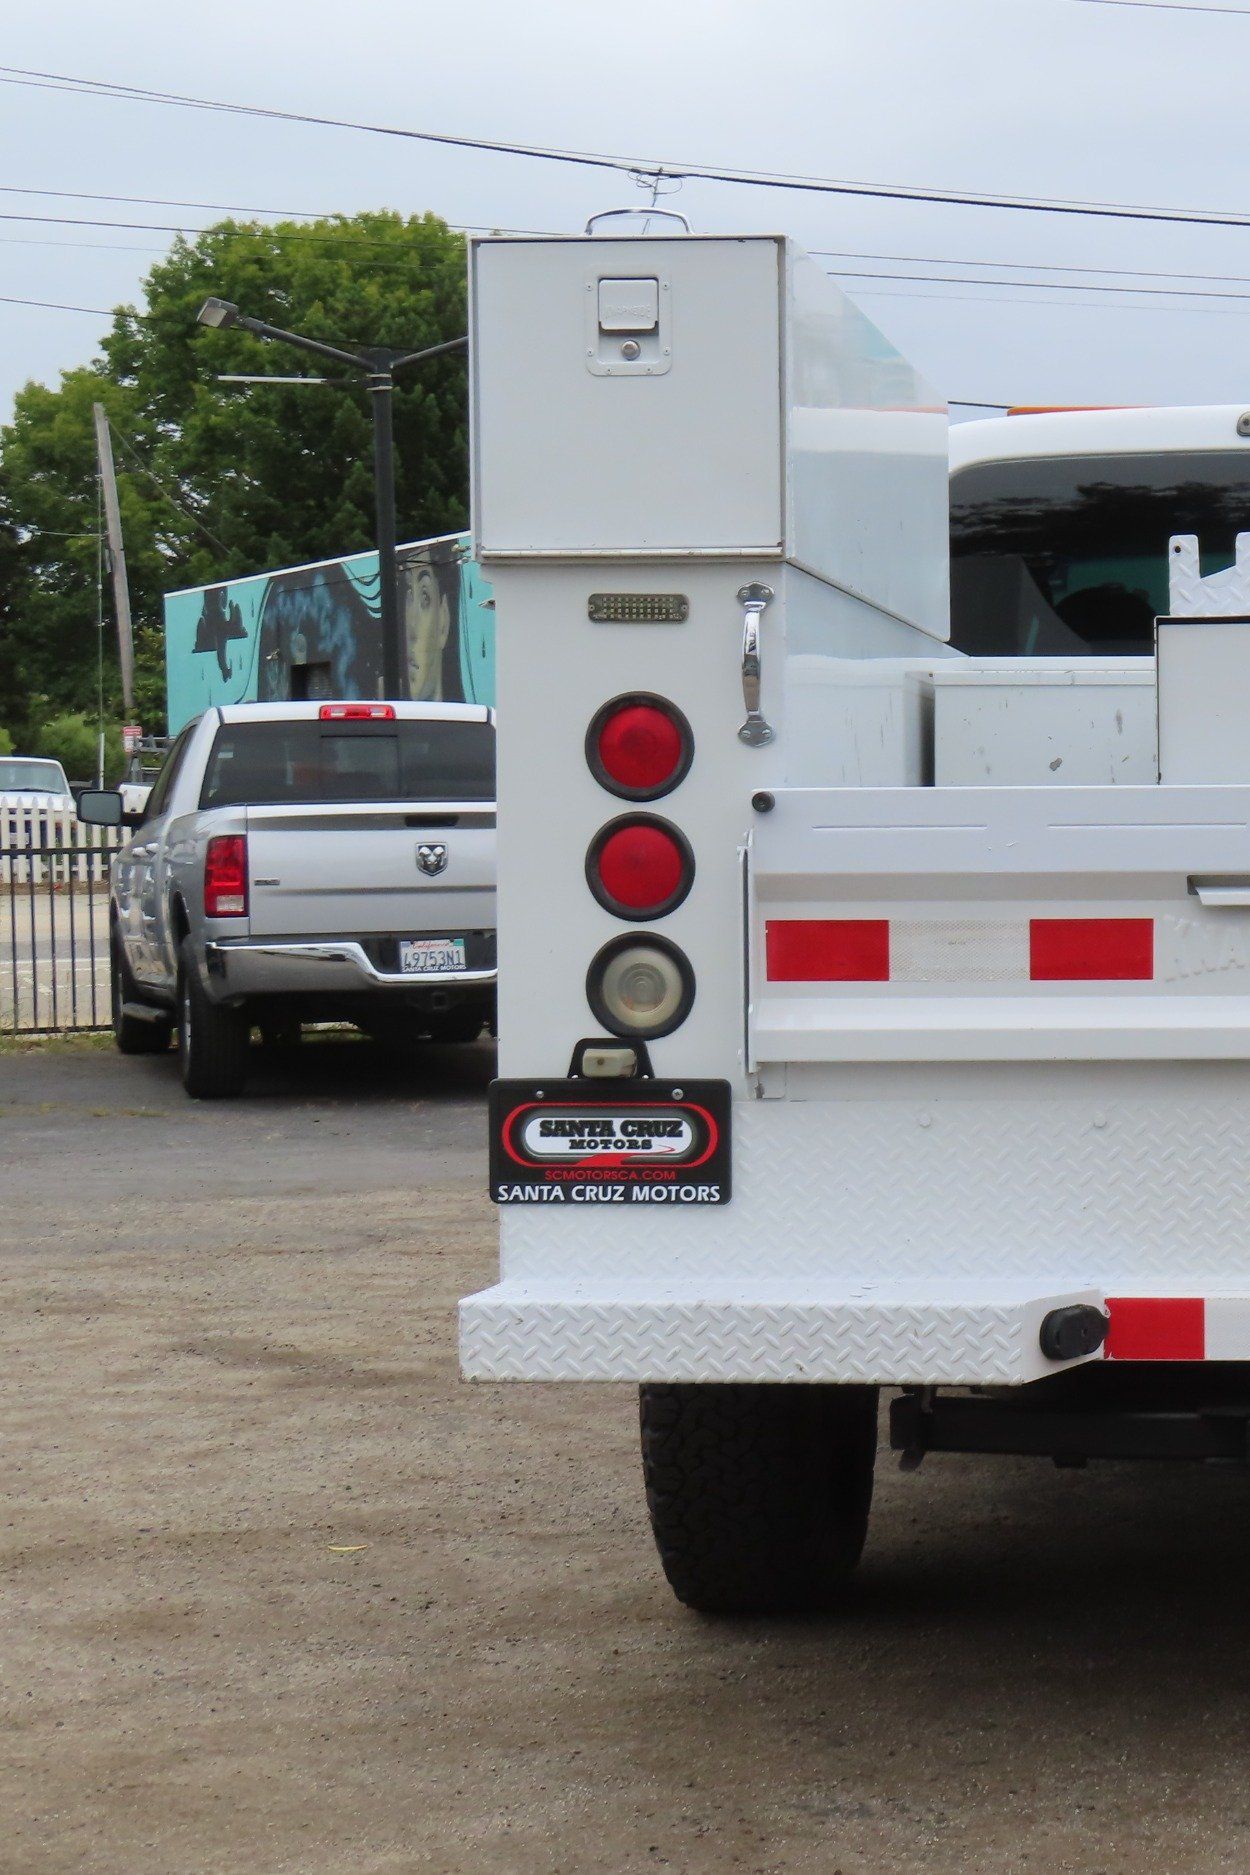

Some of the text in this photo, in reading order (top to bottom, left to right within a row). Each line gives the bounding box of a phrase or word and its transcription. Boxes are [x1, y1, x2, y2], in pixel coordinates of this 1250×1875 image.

[539, 1119, 683, 1138] SANTA CRUZ
[569, 1139, 652, 1150] MOTORS
[544, 1170, 676, 1181] SCMOTORSCA.COM
[498, 1185, 720, 1202] SANTA CRUZ MOTORS
